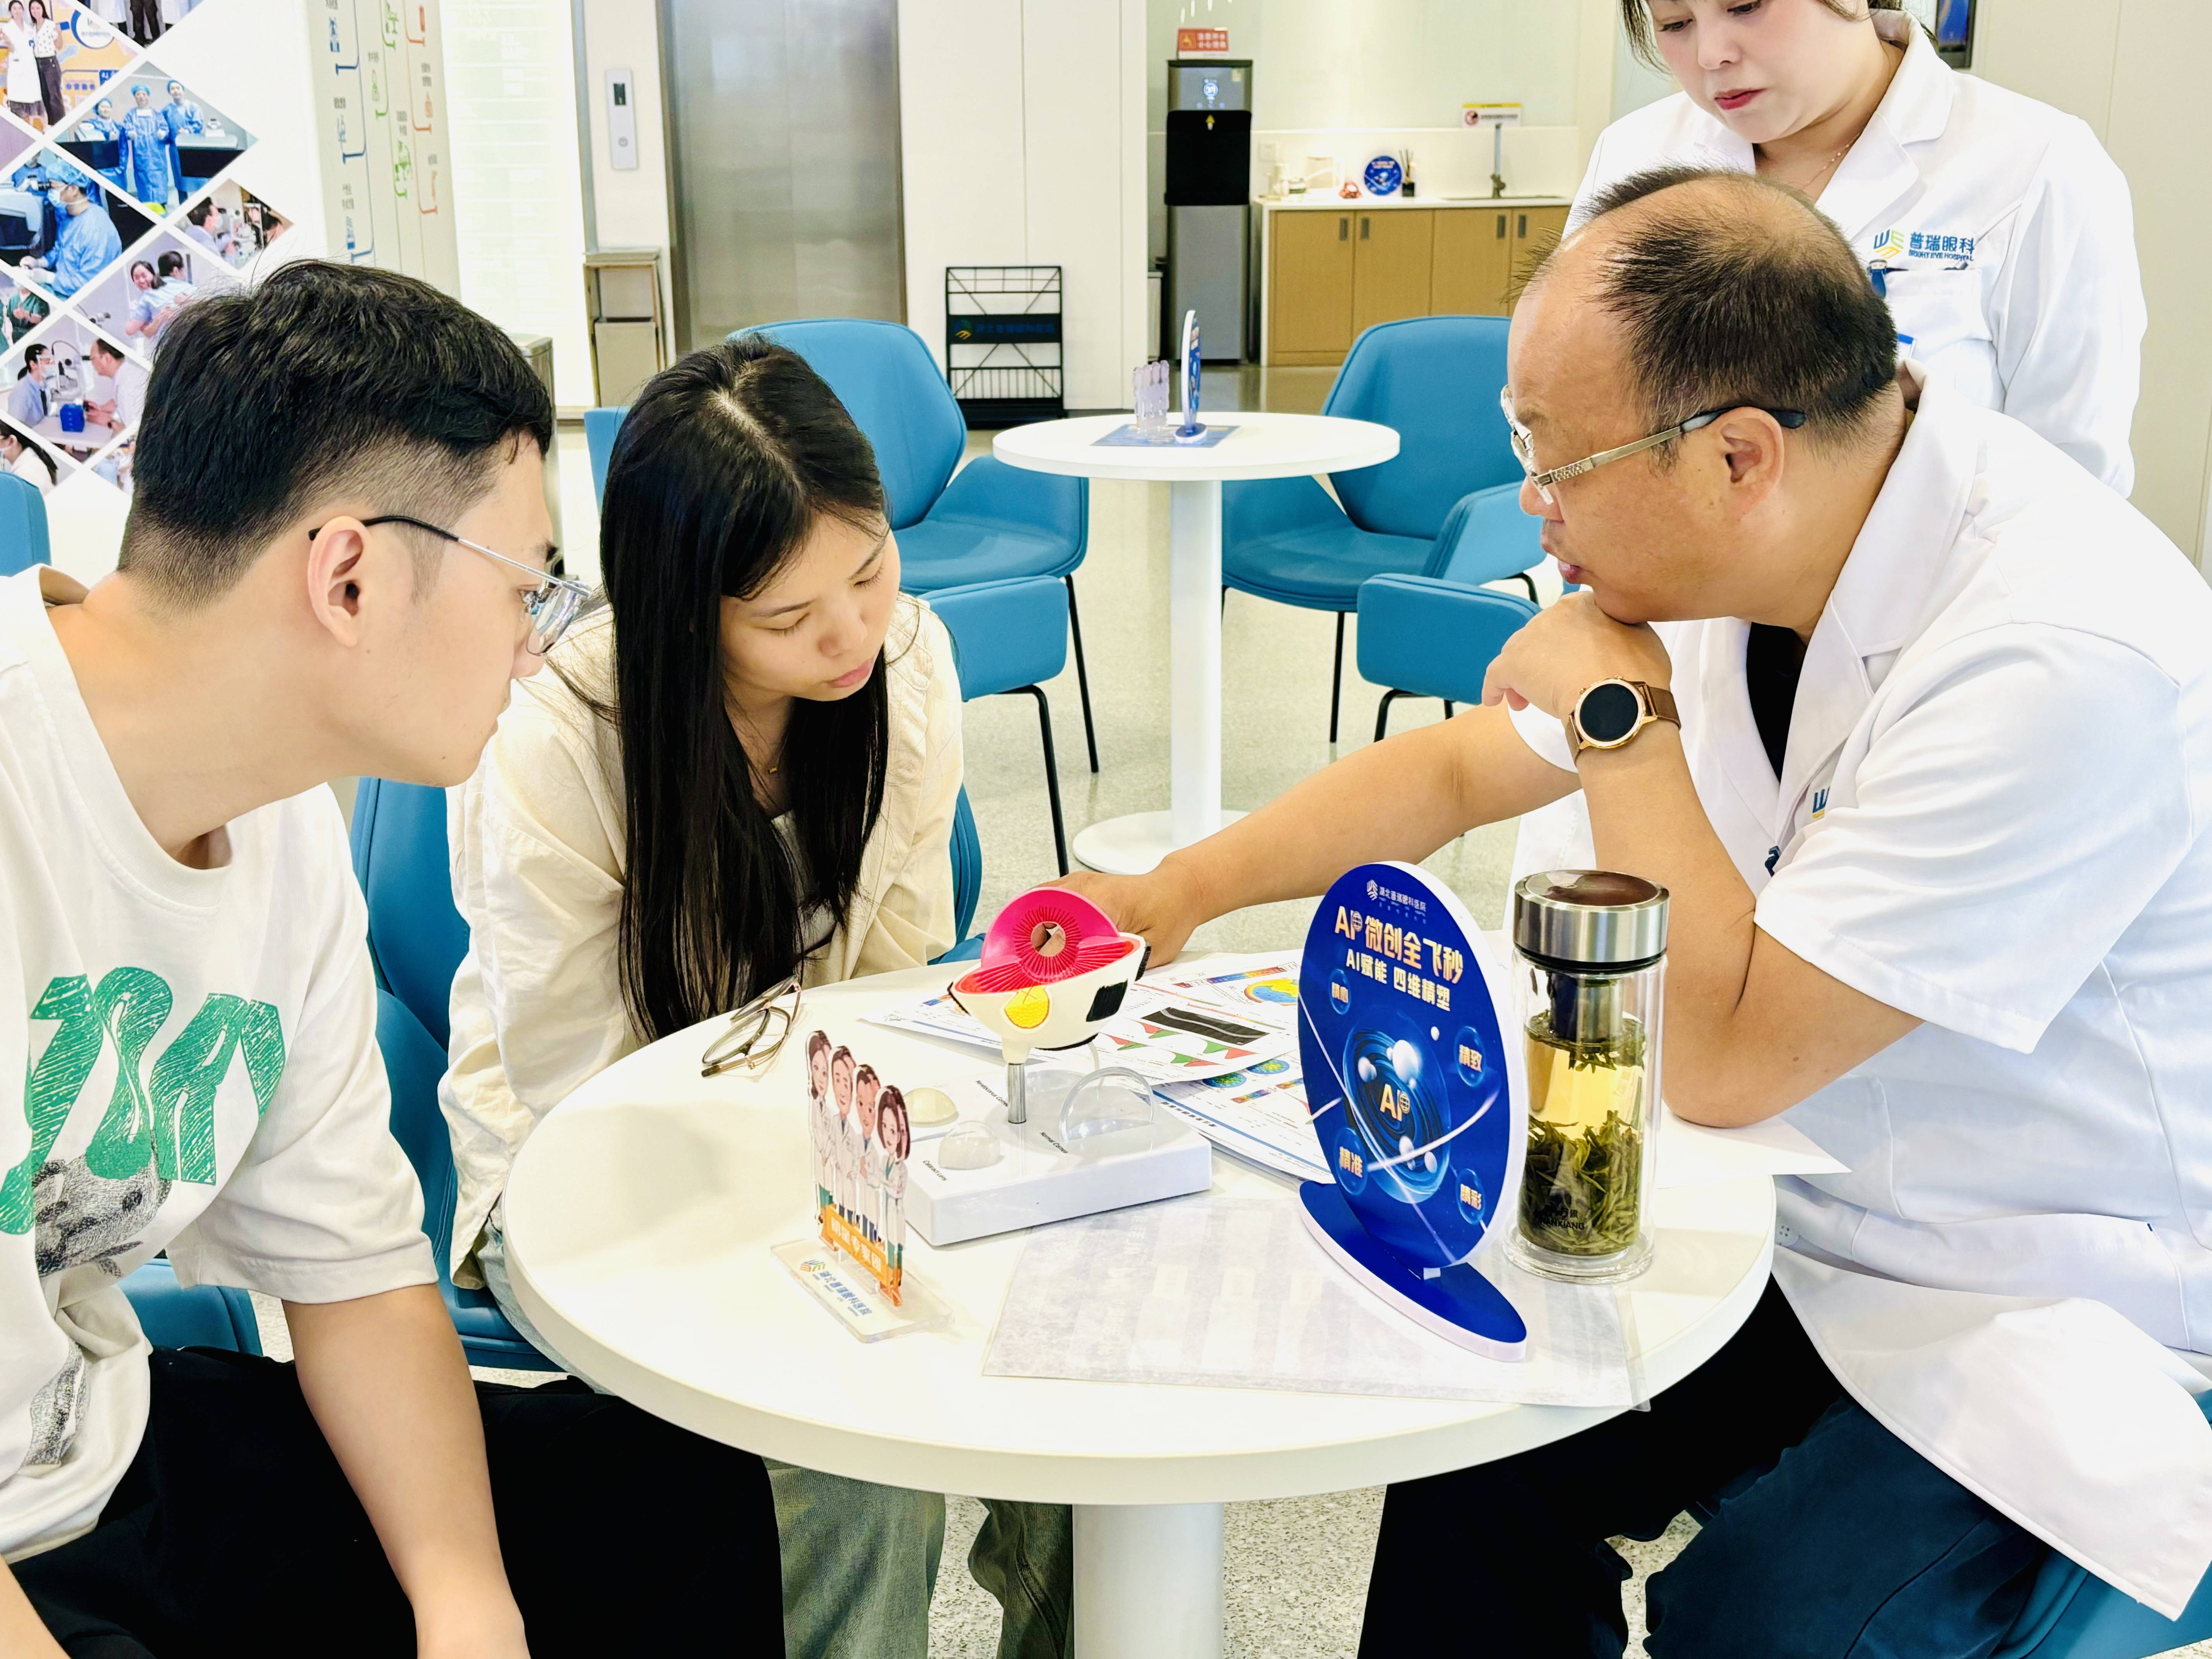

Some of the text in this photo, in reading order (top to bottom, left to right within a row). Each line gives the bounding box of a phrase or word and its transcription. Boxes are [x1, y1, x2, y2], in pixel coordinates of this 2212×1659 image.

[1908, 249, 1929, 259] BRIGHT
[1910, 232, 1975, 254] 普瑞眼科
[1346, 948, 1450, 1012] AI赋能 四维精塑
[1459, 1044, 1482, 1072] 精致
[1339, 1146, 1363, 1178] 精准
